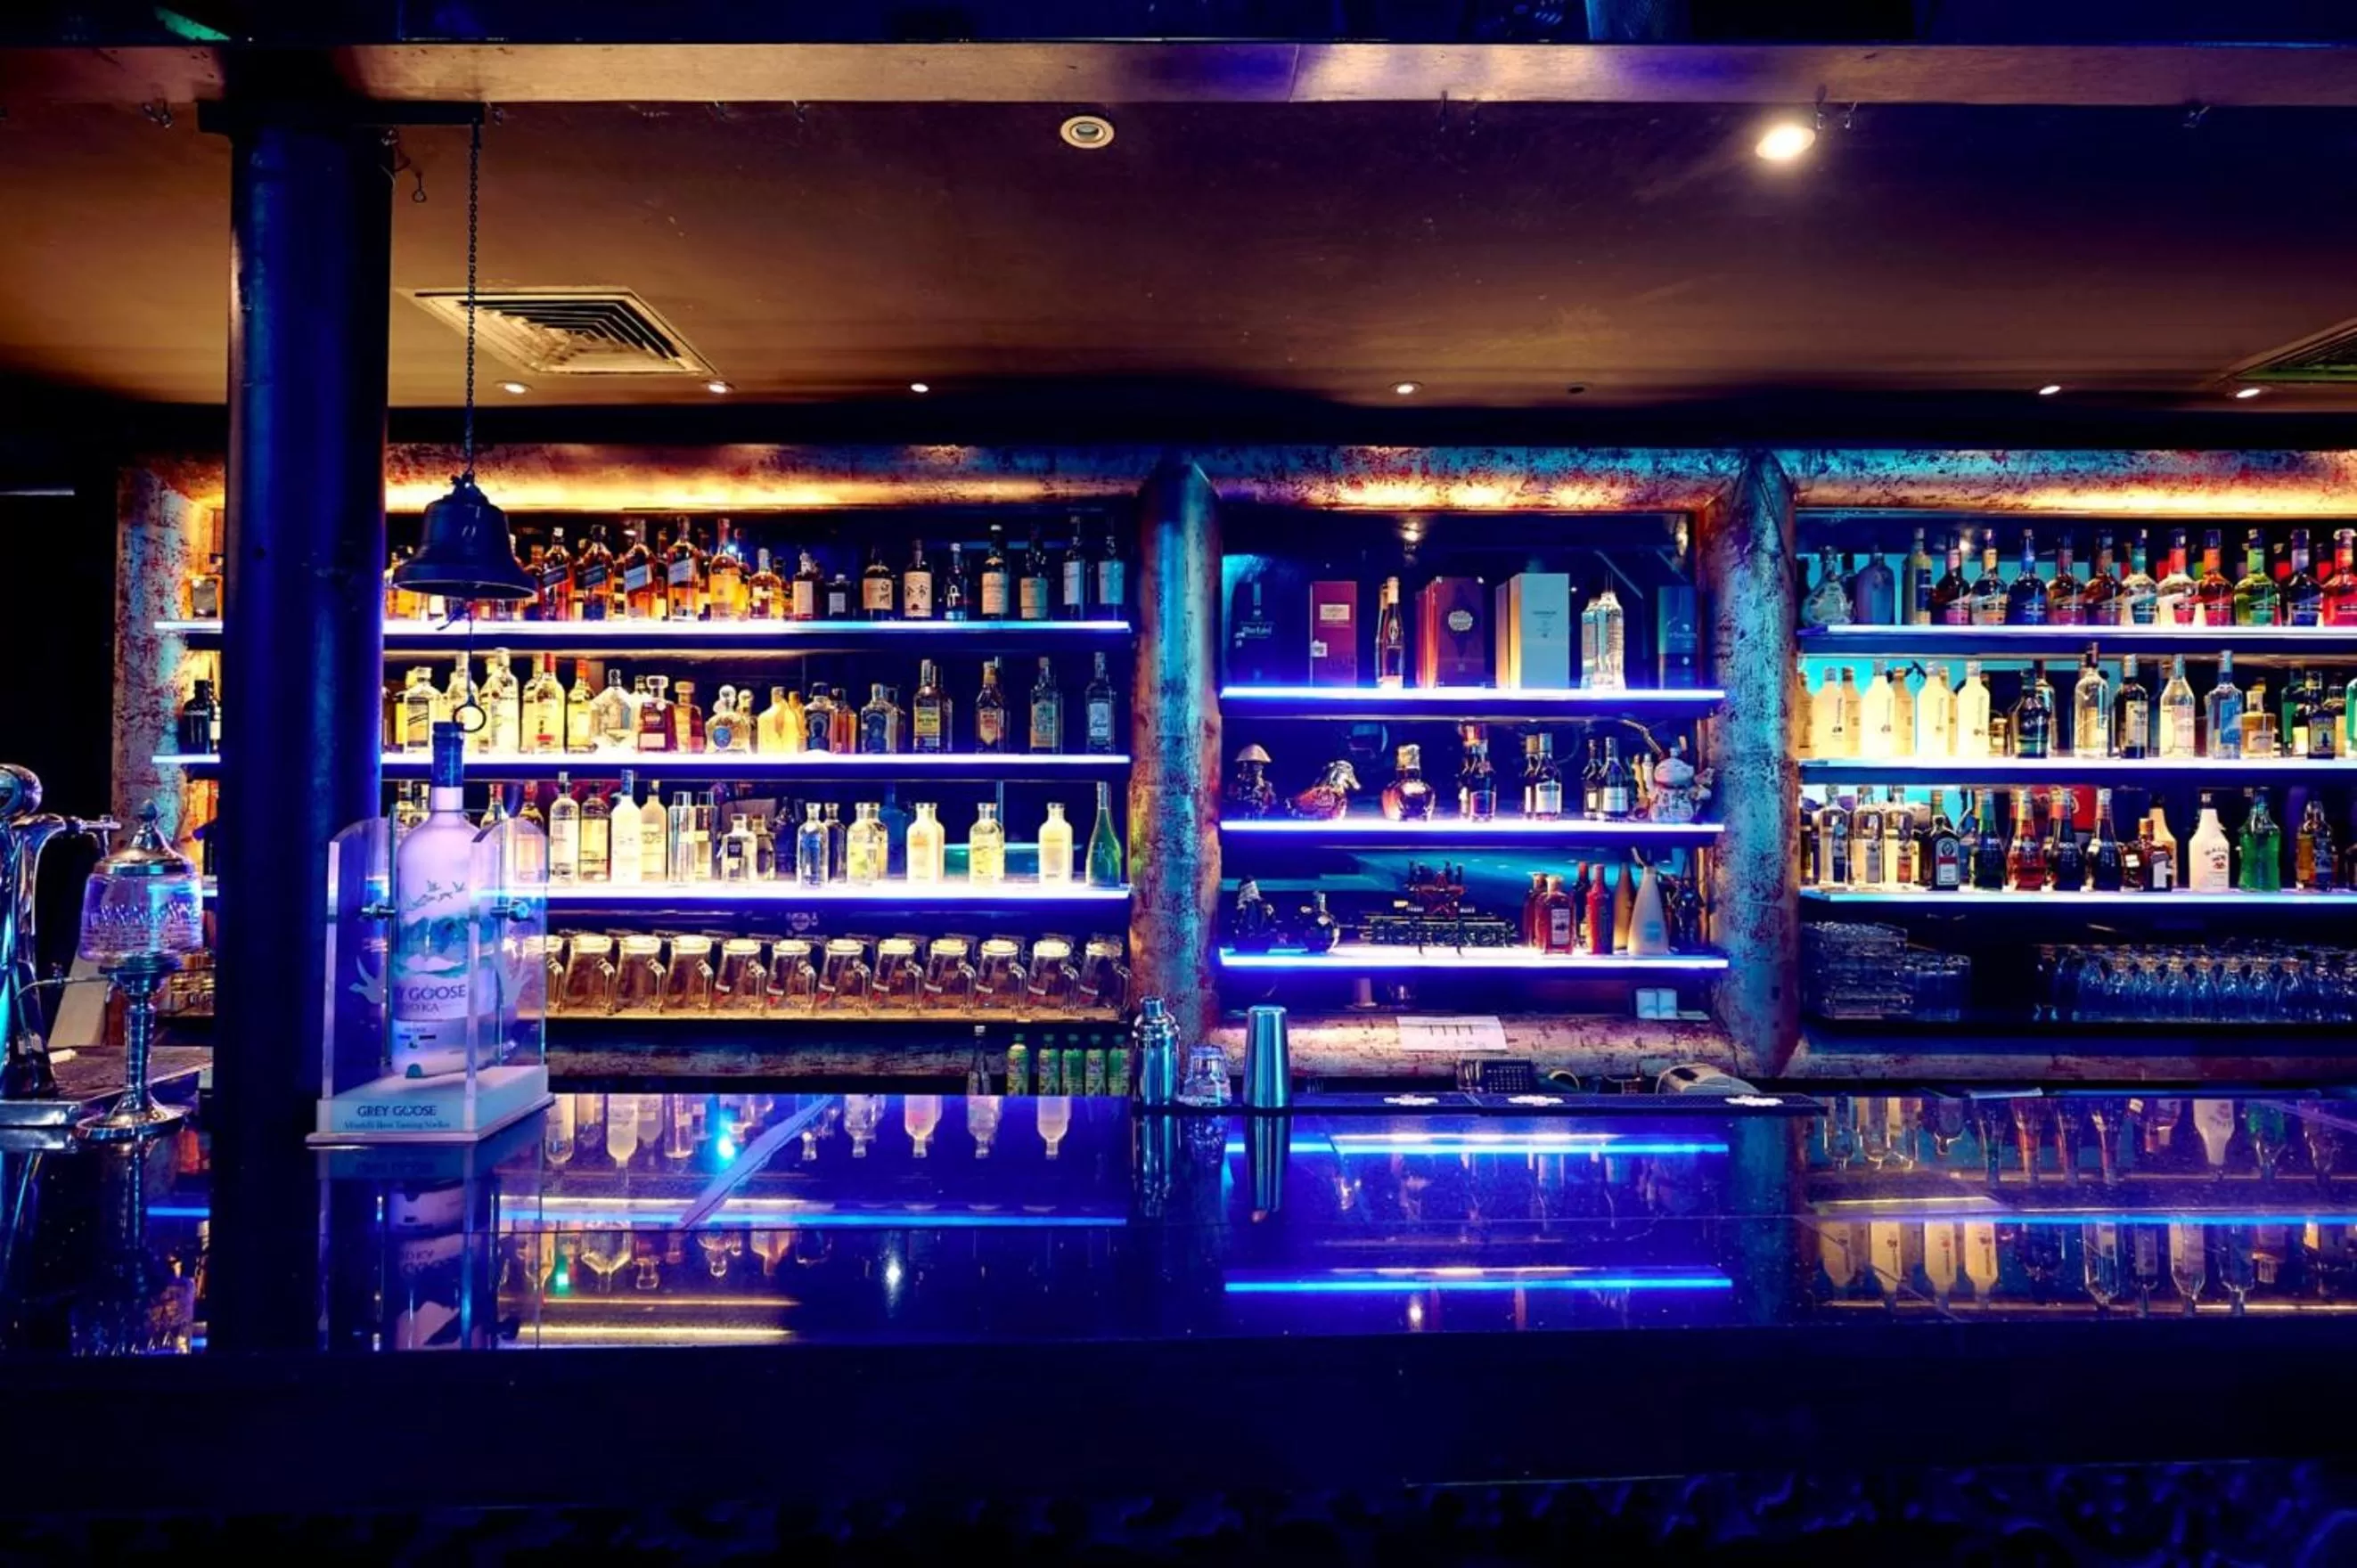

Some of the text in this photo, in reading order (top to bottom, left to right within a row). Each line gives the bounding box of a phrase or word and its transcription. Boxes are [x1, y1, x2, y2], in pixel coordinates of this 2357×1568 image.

[408, 984, 467, 1000] GOOSE
[357, 1105, 438, 1117] GREY GOOSE
